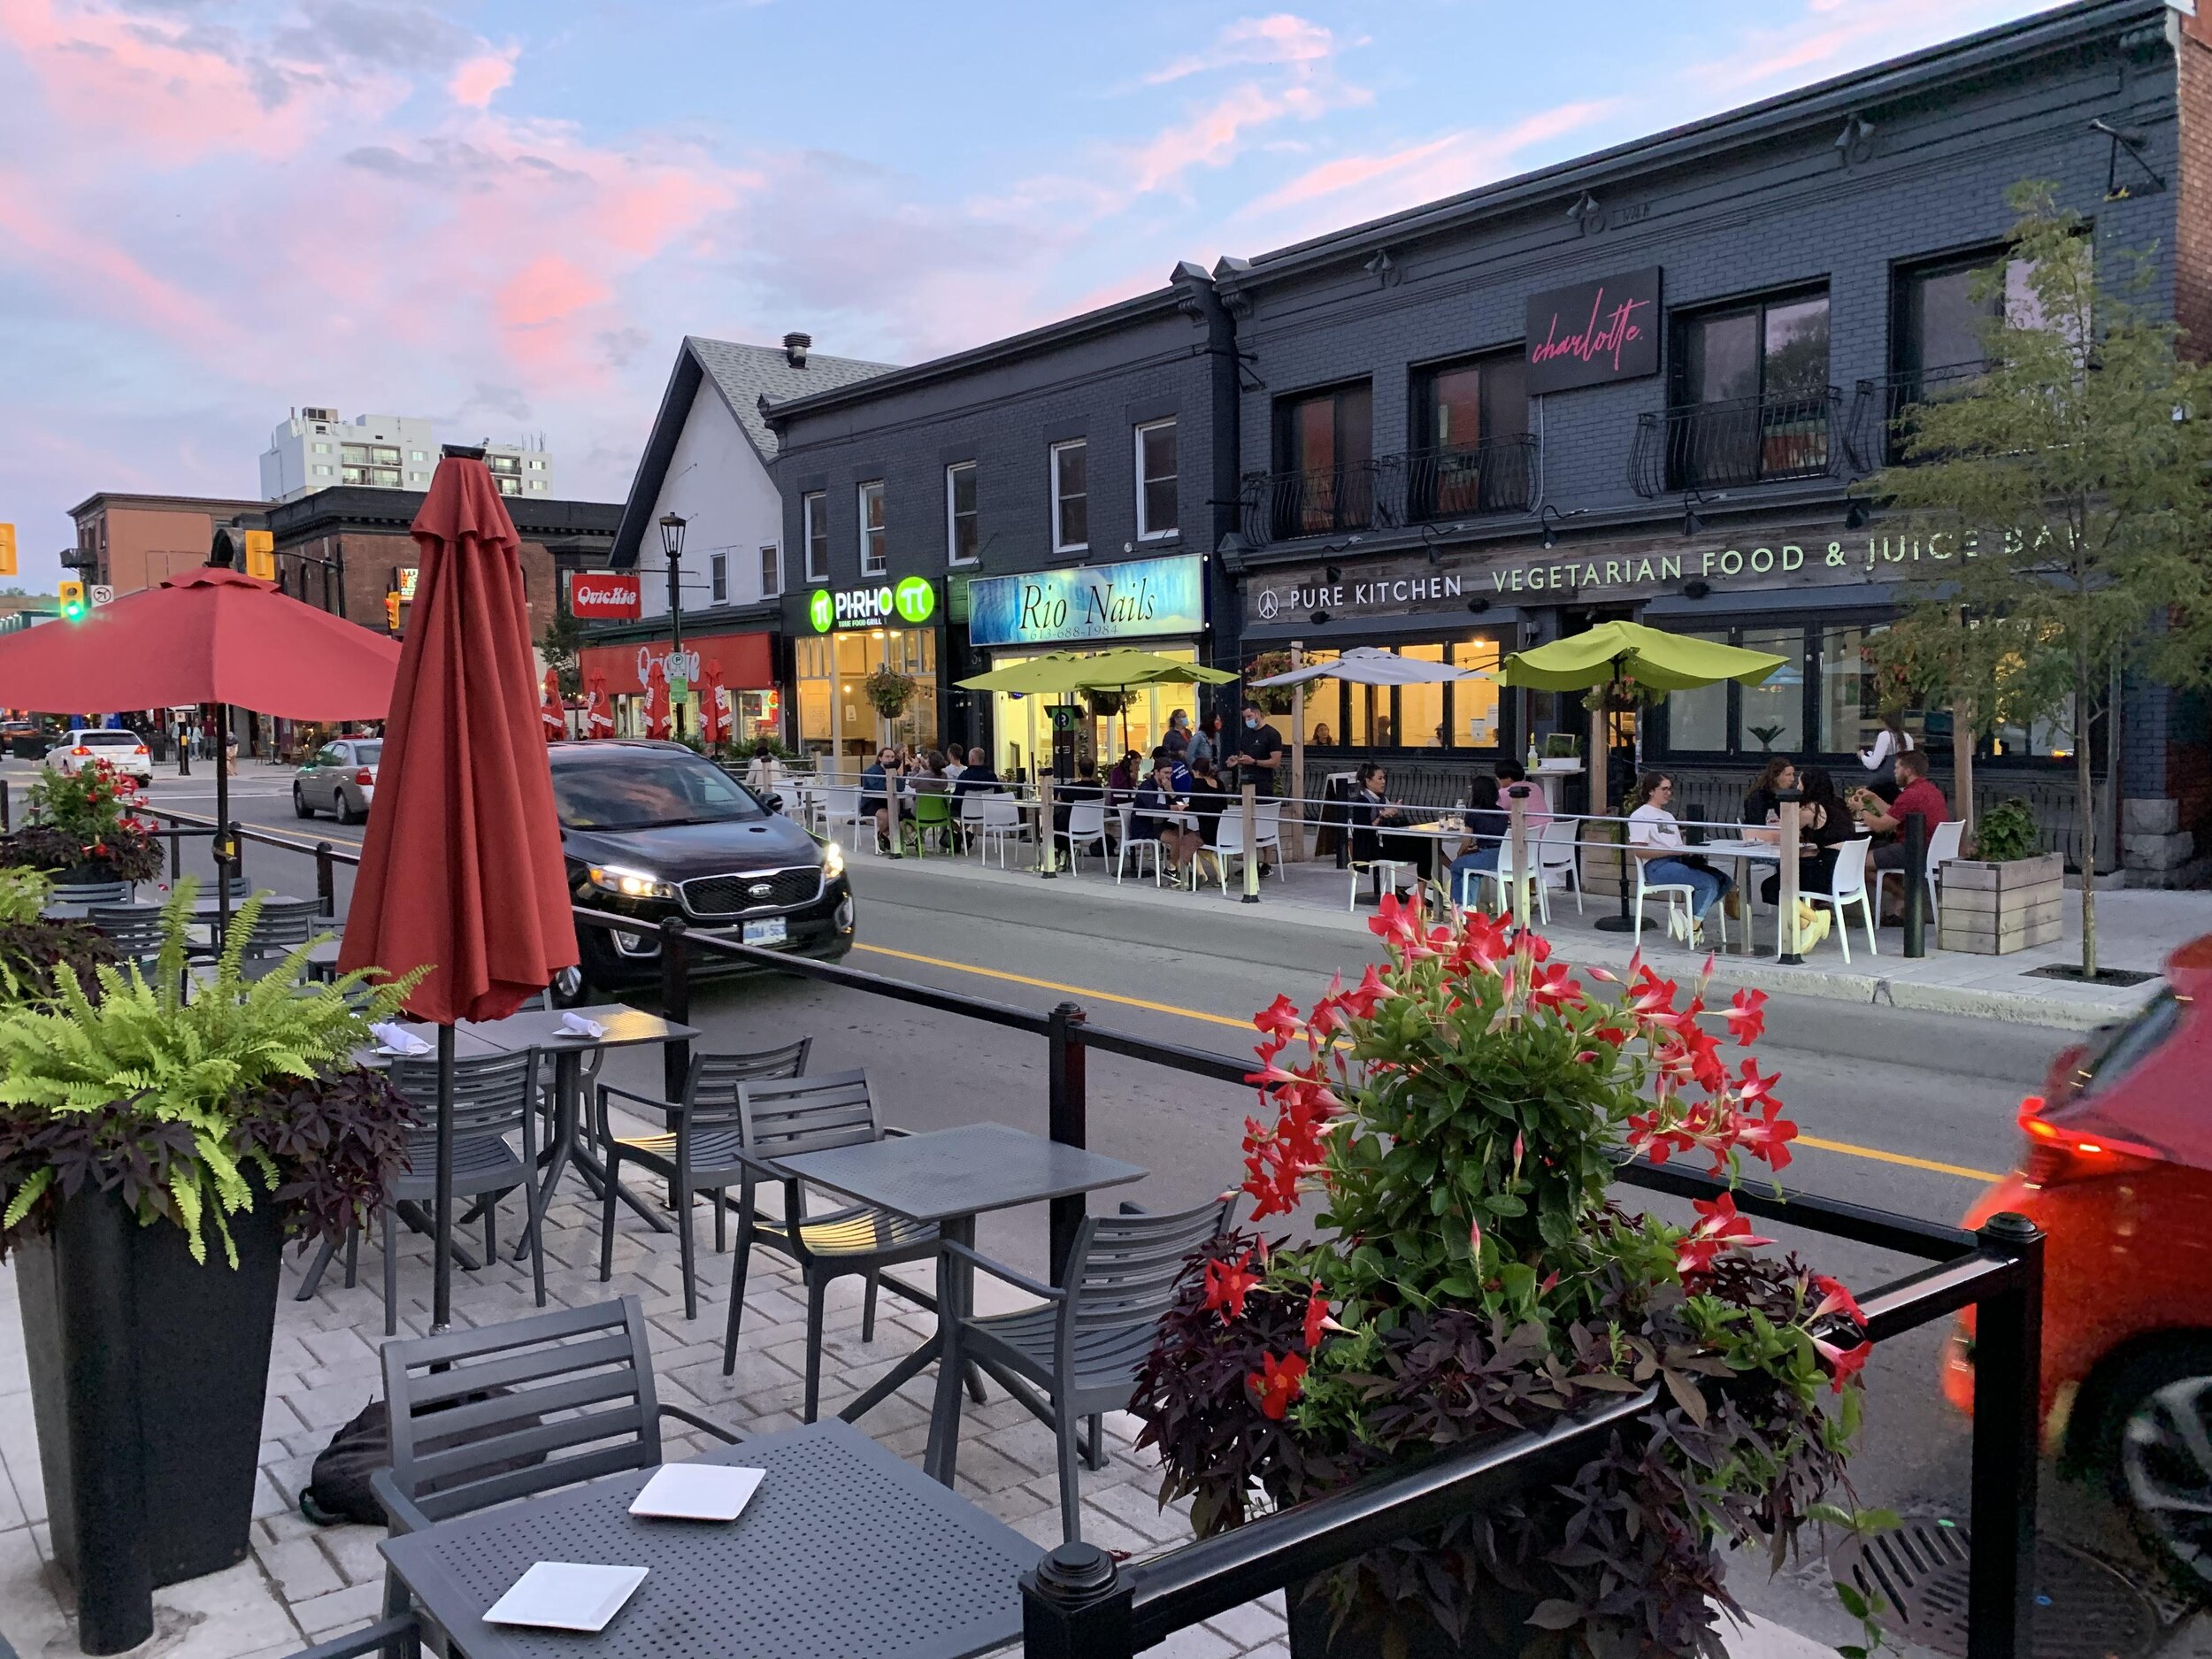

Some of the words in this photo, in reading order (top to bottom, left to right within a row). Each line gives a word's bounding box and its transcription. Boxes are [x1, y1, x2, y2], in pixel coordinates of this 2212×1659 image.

[1290, 586, 1344, 610] PURE
[1355, 575, 1463, 605] KITCHEN
[1492, 556, 1682, 593] VEGETARIAN
[1702, 545, 1804, 576] FOOD
[1825, 541, 1846, 566] &
[1865, 531, 1979, 571] JUICE
[1020, 585, 1067, 629] Rio
[1085, 578, 1155, 624] Nails
[852, 618, 866, 627] FOOD
[866, 618, 882, 626] GRILL
[1030, 625, 1119, 640] 613-688-1984
